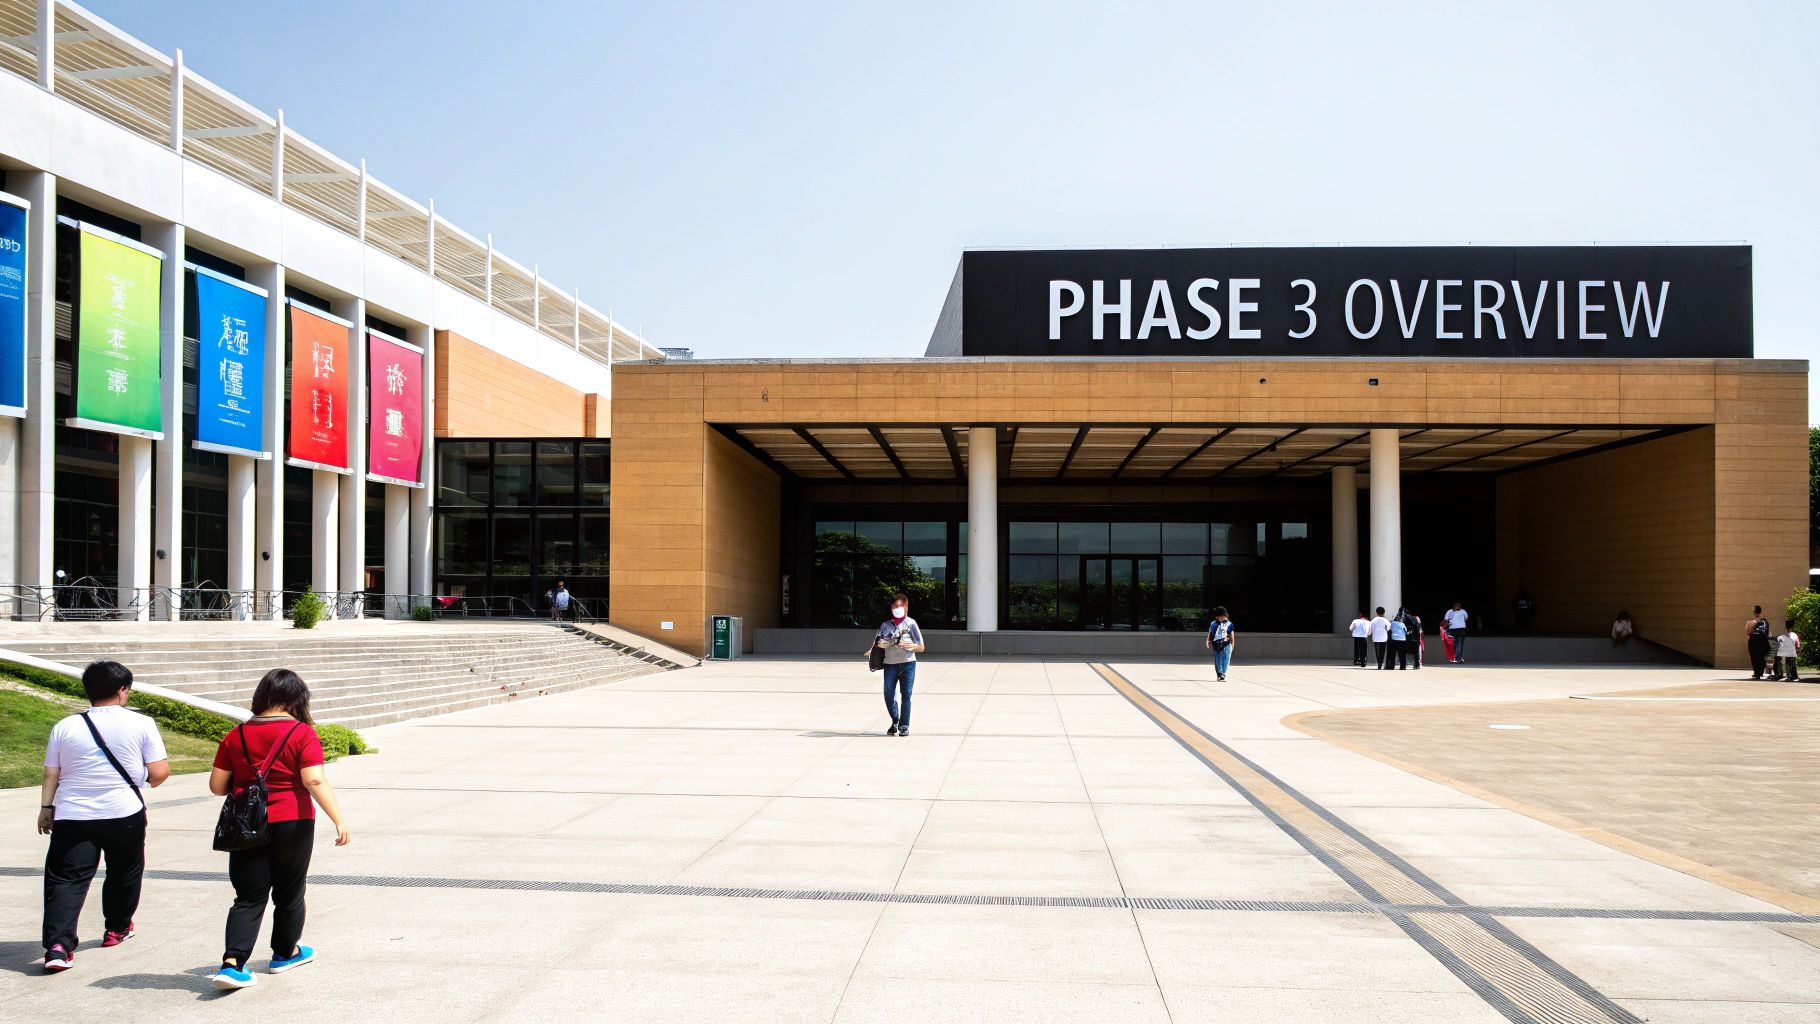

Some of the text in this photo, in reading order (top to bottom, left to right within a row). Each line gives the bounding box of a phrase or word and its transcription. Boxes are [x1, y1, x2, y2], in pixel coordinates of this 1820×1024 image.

[1048, 277, 1671, 341] PHASE 3 OVERVIEW
